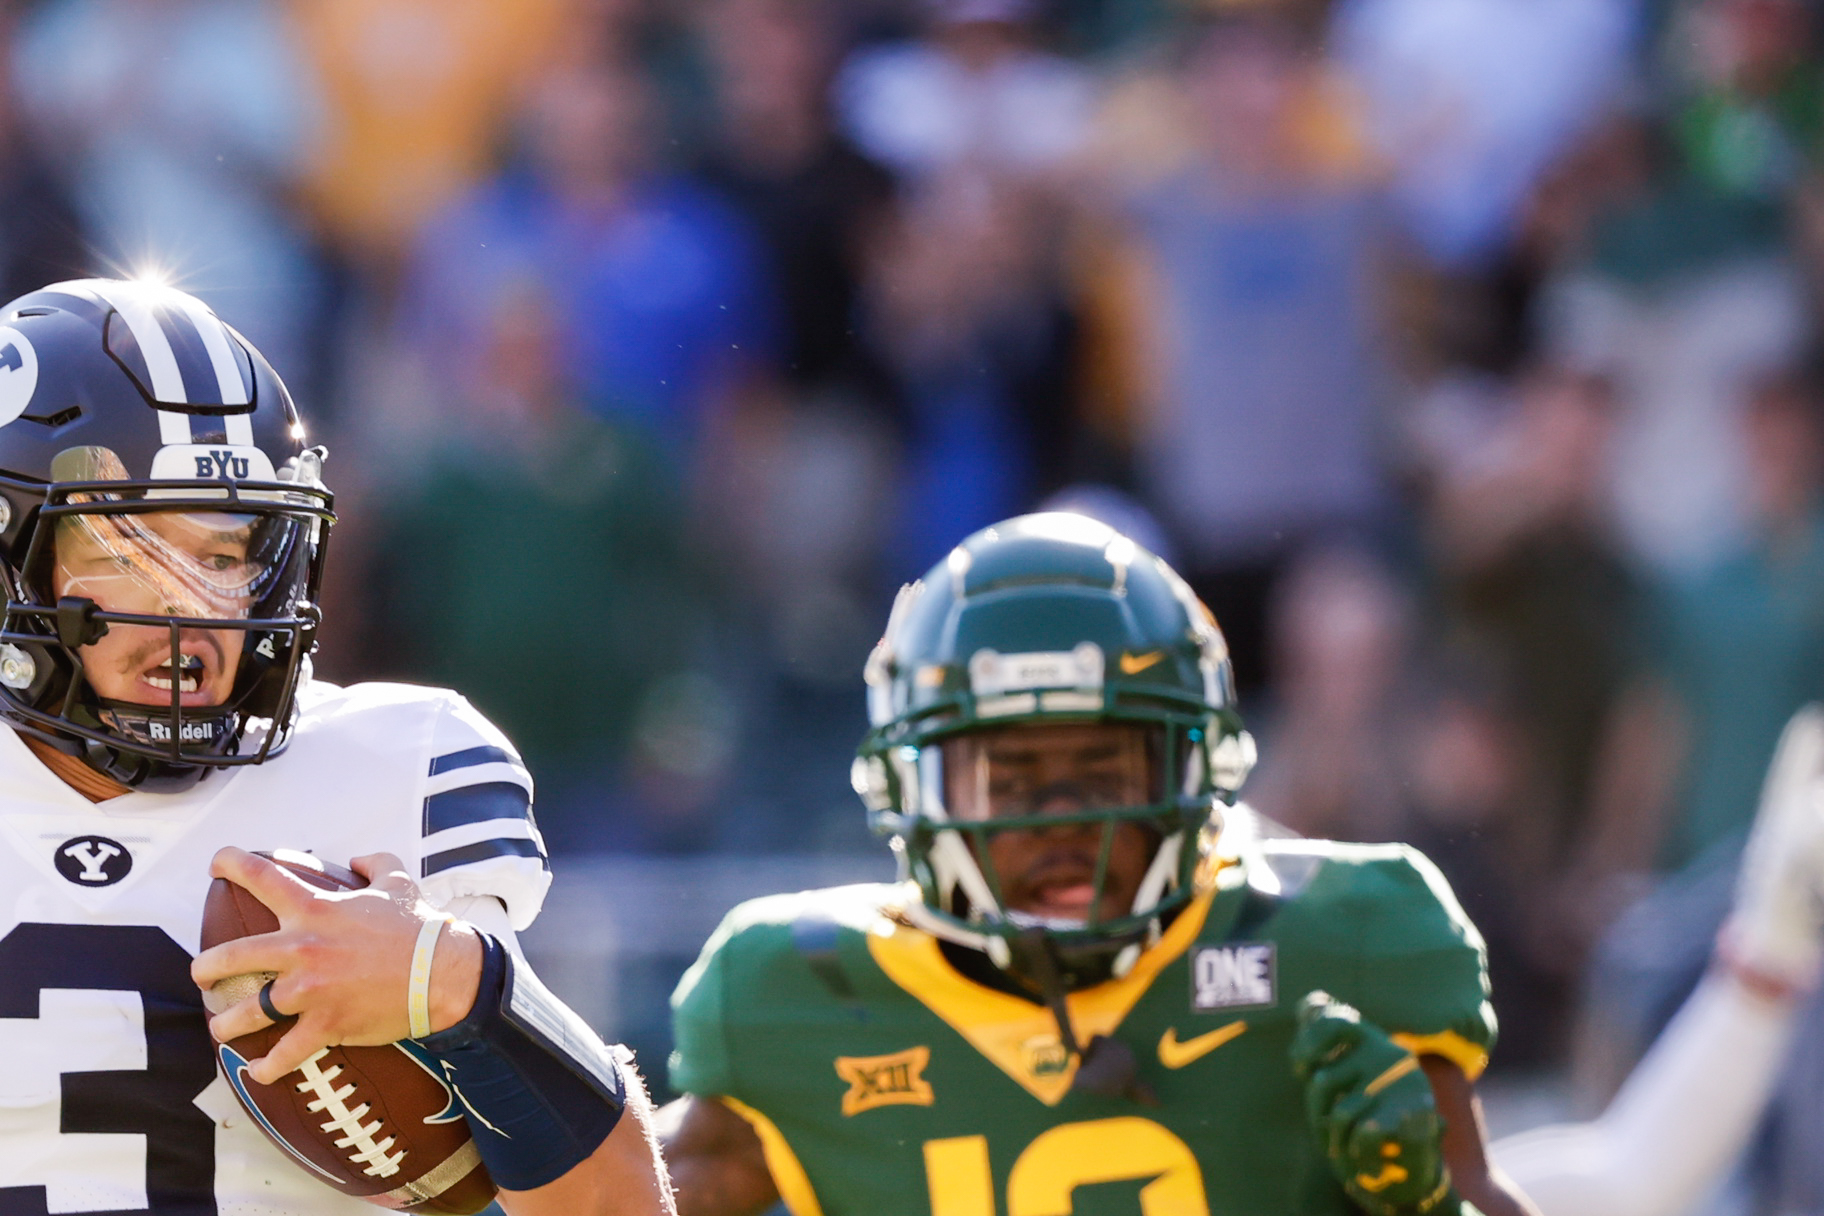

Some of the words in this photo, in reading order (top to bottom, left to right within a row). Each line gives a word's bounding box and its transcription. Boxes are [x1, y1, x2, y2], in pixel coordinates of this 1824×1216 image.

[194, 450, 250, 480] BYU
[149, 722, 212, 739] Ridell
[64, 841, 121, 881] Y
[1195, 946, 1271, 989] ONE
